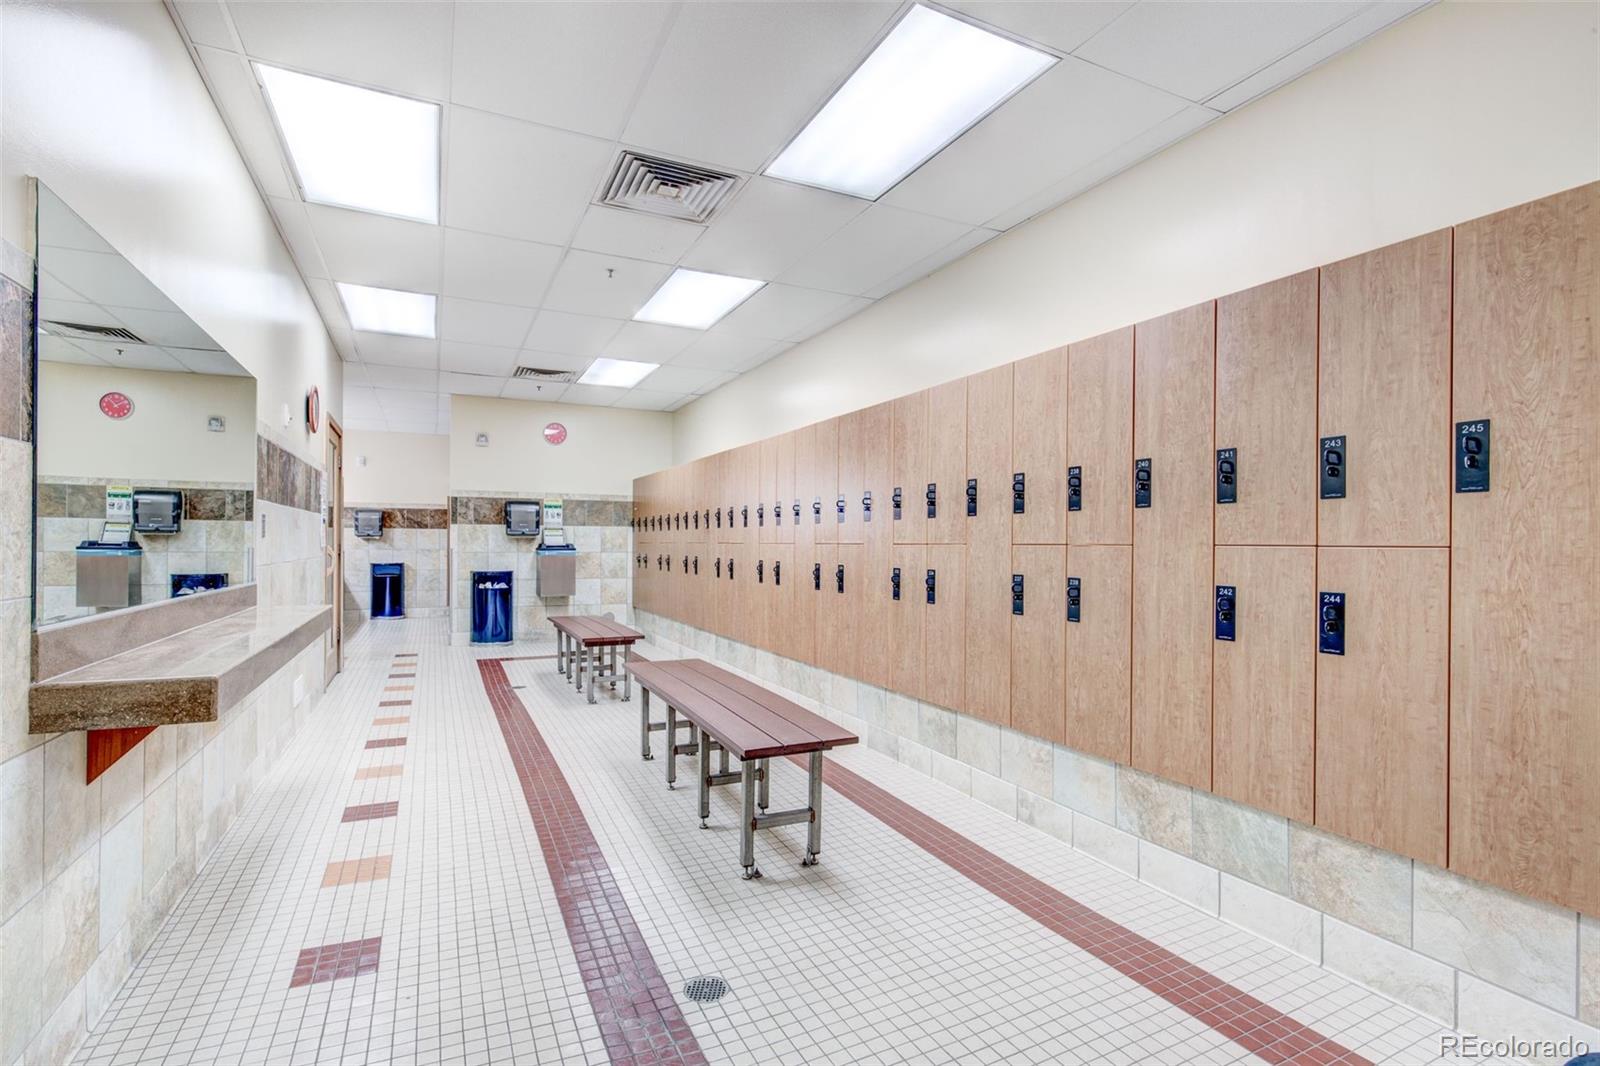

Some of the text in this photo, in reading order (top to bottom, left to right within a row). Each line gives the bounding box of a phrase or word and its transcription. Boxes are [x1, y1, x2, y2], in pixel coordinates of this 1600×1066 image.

[1462, 424, 1483, 434] 245
[1325, 439, 1341, 448] 243
[1219, 588, 1233, 596] 242
[1324, 595, 1341, 603] 244
